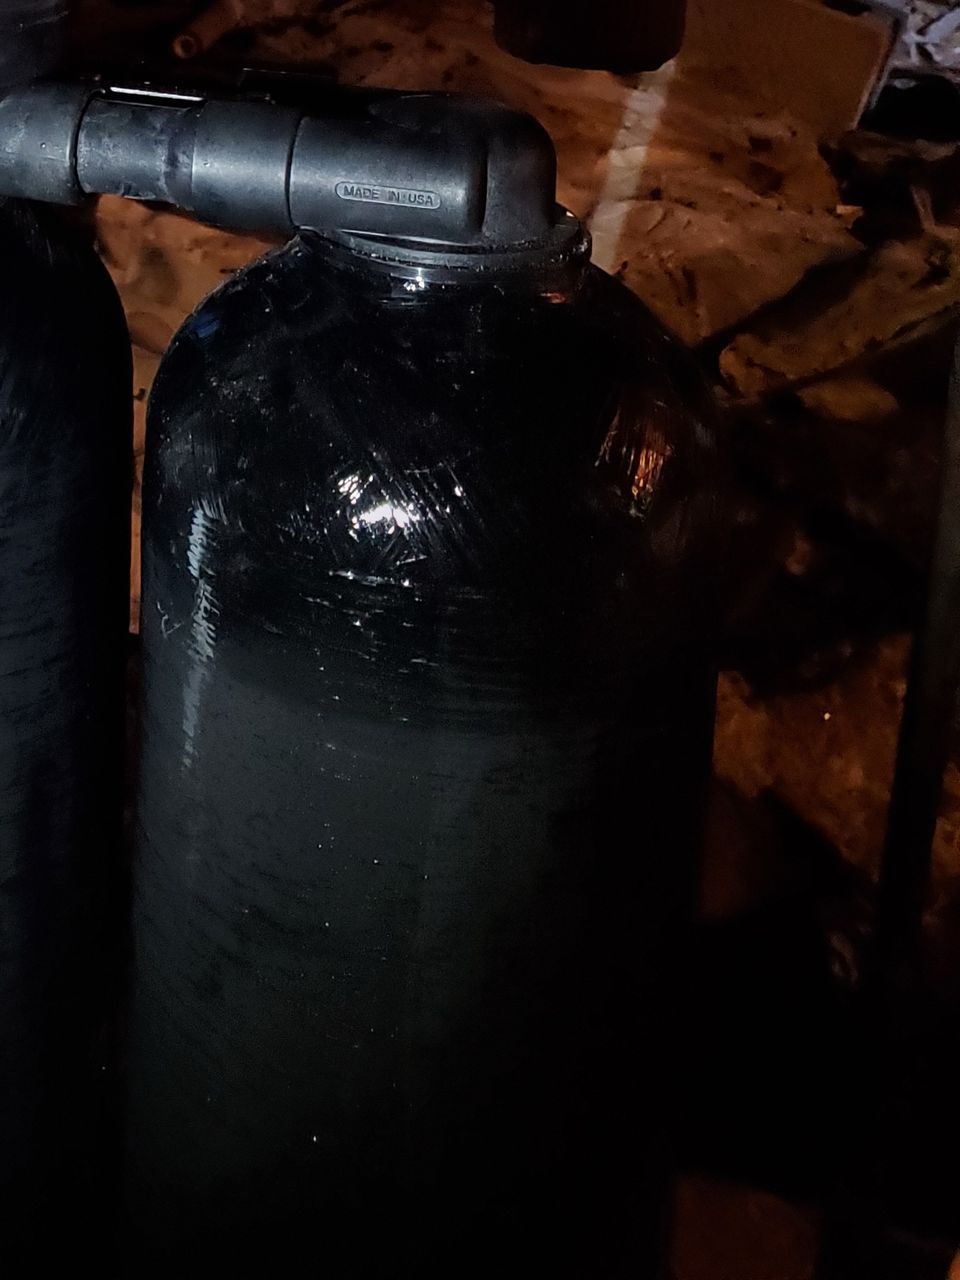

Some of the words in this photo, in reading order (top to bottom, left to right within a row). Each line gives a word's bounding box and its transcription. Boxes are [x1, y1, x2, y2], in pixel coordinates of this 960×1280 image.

[343, 184, 379, 199] MADE
[388, 190, 400, 202] IN
[408, 193, 434, 206] USA
